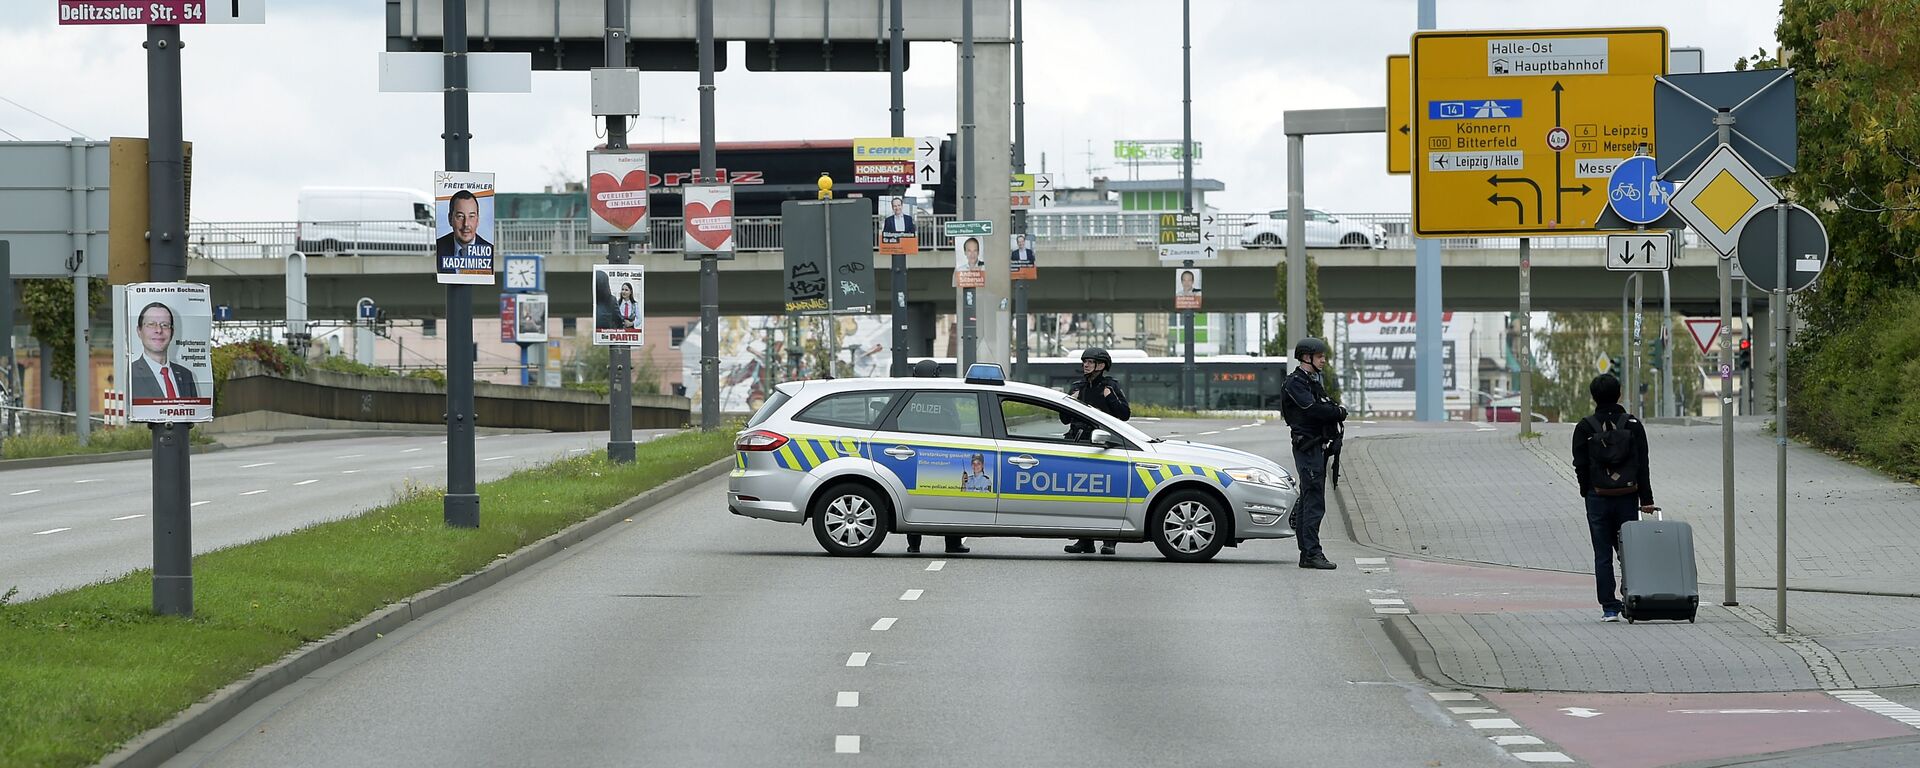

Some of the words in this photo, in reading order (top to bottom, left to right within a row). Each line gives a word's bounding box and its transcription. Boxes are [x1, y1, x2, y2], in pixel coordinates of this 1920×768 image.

[60, 4, 143, 21] Delitzscher
[150, 4, 177, 22] Str.
[183, 4, 203, 20] 54
[1491, 42, 1553, 54] Halle-Ost
[1514, 58, 1604, 74] Hauptbahnhof
[1447, 105, 1458, 115] 14
[1456, 122, 1511, 134] Könnern
[1583, 127, 1589, 135] 6
[1603, 124, 1649, 138] Leipzig
[1432, 138, 1448, 148] 100
[1457, 136, 1517, 149] Bitterfeld
[1581, 142, 1592, 152] 91
[1603, 140, 1654, 154] Mersebg
[857, 146, 865, 155] E
[868, 146, 913, 156] center
[856, 164, 904, 175] HORNBACH
[855, 175, 890, 184] Delitzscher
[906, 175, 915, 183] 54
[443, 182, 464, 190] FREIE
[466, 181, 493, 190] WÄHLER
[601, 191, 634, 200] VERLIEBT
[620, 199, 642, 208] HALLE
[467, 245, 493, 257] FALKO
[442, 256, 493, 269] KADZIMIRSZ
[148, 286, 176, 294] Martin
[609, 333, 639, 342] PARTEI
[1391, 346, 1408, 360] IN
[167, 408, 196, 416] PARTEI
[910, 402, 941, 414] POLIZEI
[1015, 470, 1111, 494] POLIZEI
